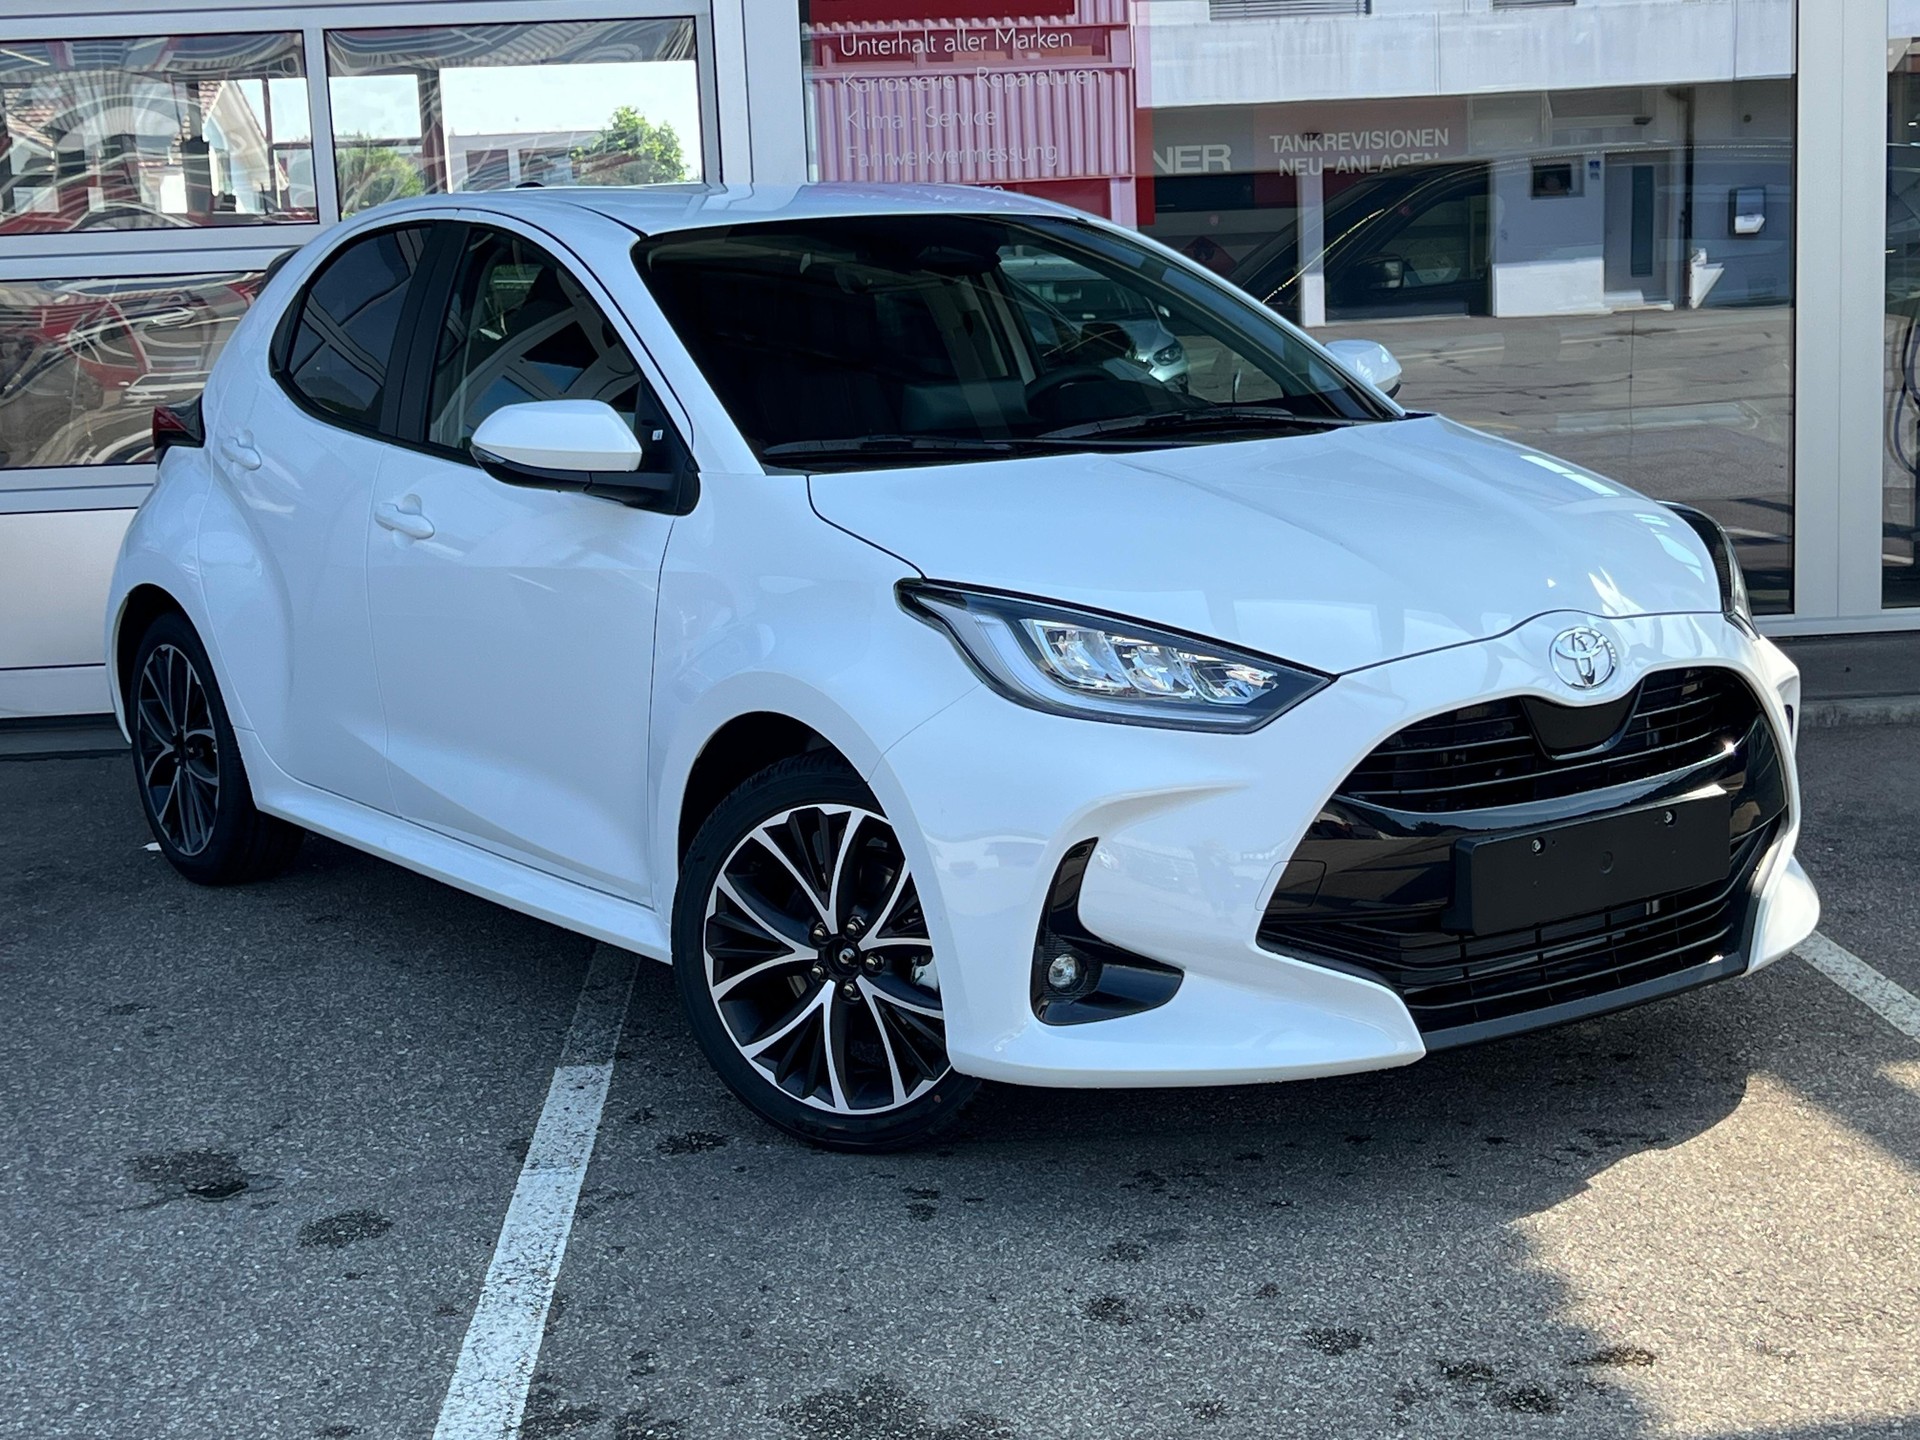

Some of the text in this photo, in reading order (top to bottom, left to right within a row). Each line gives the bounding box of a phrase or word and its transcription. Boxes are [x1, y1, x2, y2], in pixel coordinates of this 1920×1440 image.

[840, 26, 1073, 56] Unterhalt aller Marken
[842, 66, 1101, 94] Karrosserie Reparaturen
[846, 107, 903, 130] Klima
[925, 105, 997, 128] Service
[1269, 128, 1449, 153] TANKREVISIONEN
[847, 143, 1058, 168] Fahrwerkvermessung
